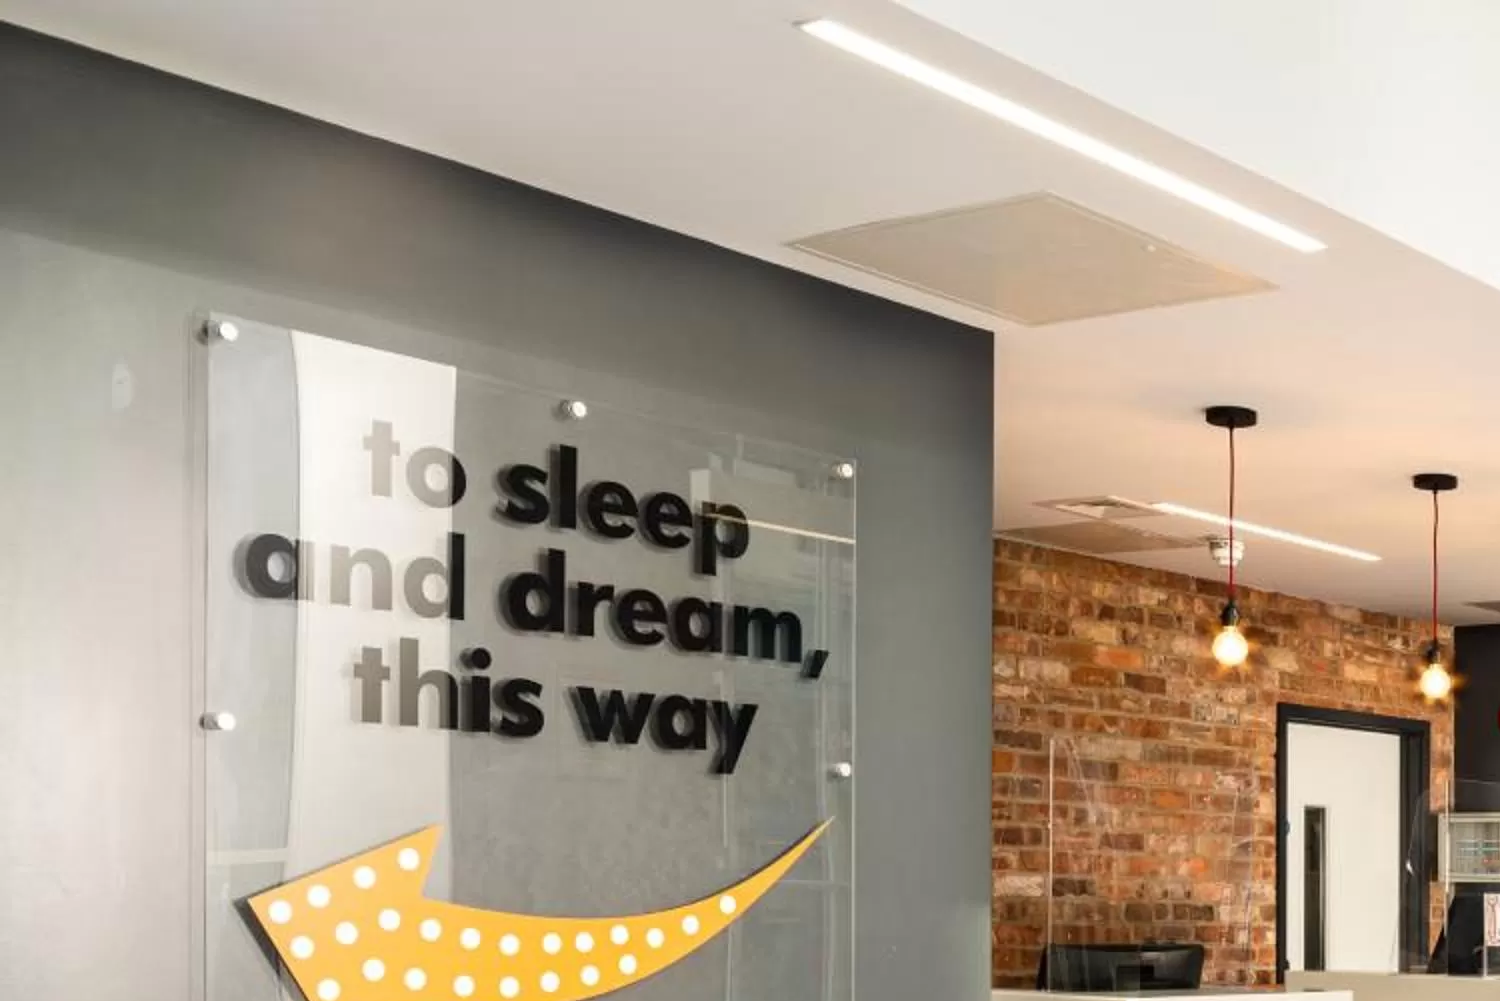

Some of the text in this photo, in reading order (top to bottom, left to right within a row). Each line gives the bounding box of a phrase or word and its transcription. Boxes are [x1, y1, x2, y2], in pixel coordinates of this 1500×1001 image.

[363, 420, 748, 575] to sleep
[238, 533, 829, 679] and dream,
[352, 638, 759, 775] this way
